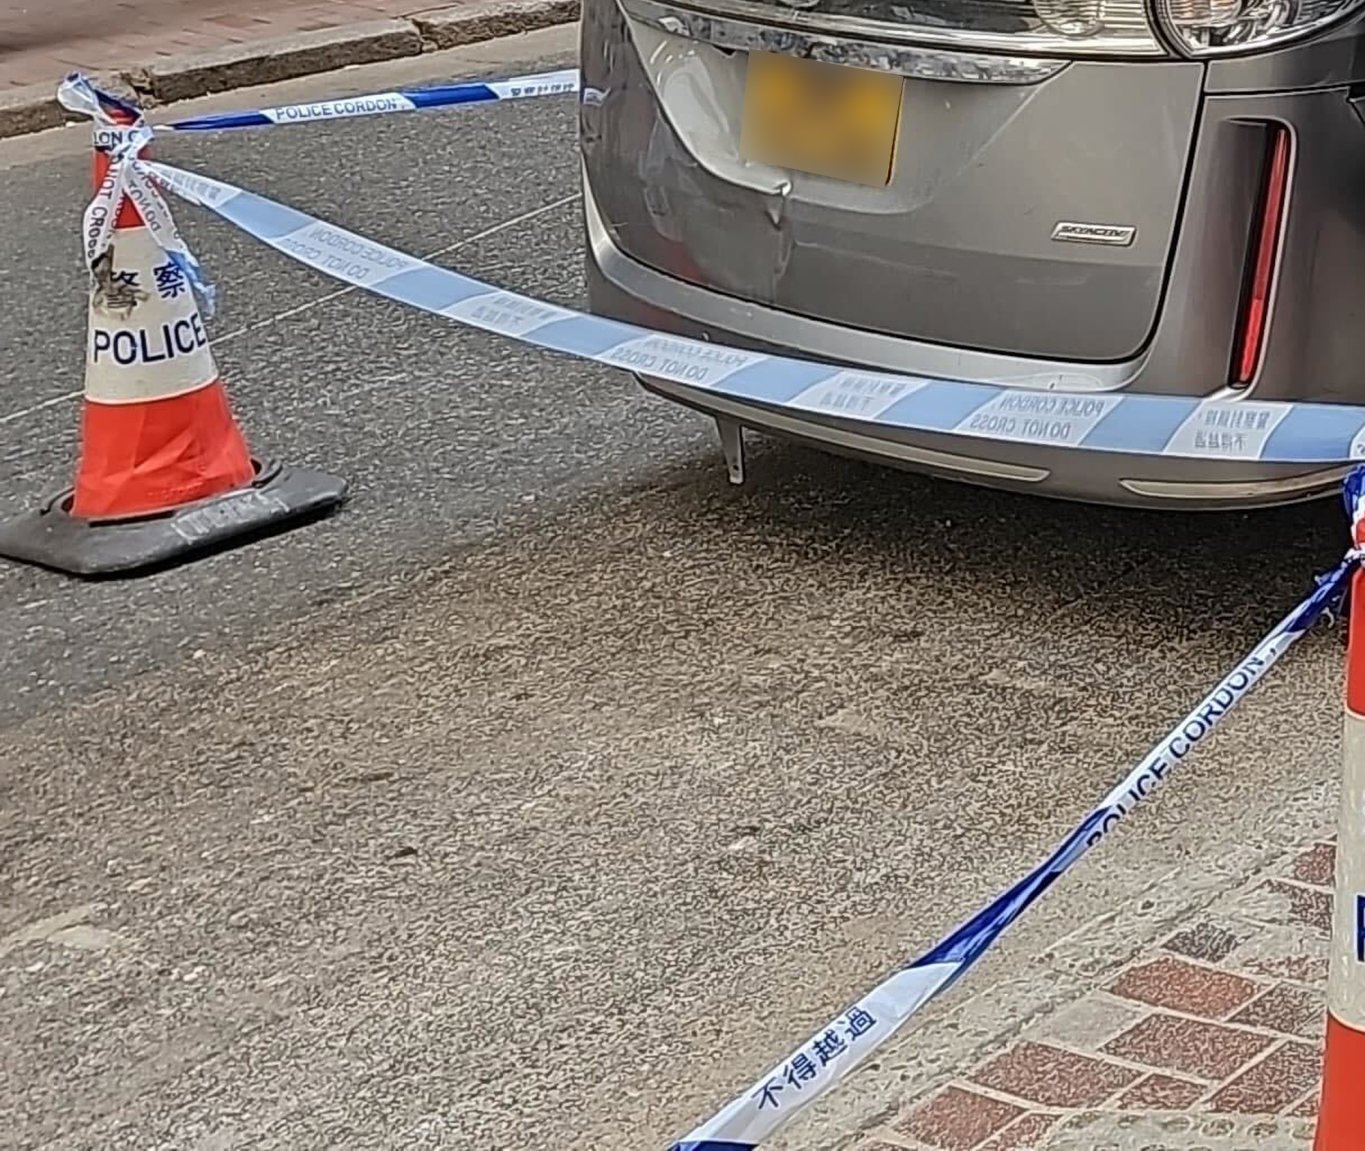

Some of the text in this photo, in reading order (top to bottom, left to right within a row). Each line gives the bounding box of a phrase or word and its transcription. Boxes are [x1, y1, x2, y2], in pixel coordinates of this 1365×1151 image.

[276, 106, 333, 120] POLICE
[94, 314, 206, 374] POLICE
[751, 1006, 877, 1109] 不得越過
